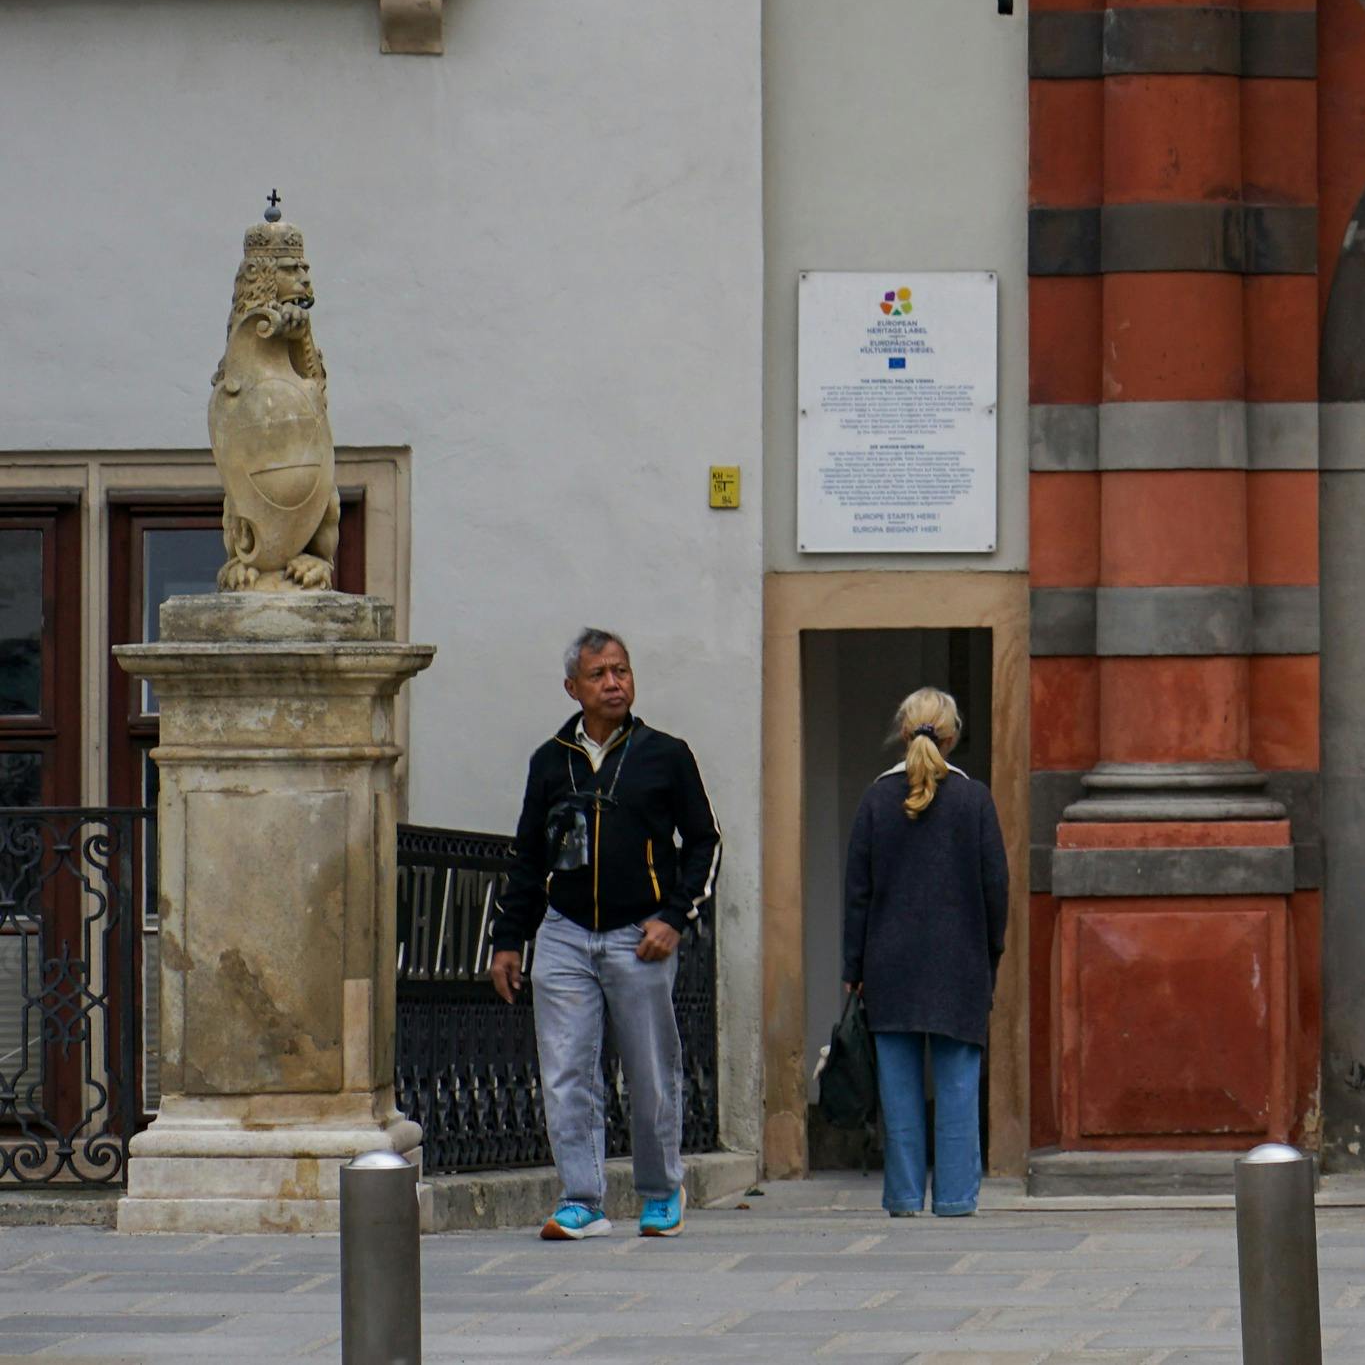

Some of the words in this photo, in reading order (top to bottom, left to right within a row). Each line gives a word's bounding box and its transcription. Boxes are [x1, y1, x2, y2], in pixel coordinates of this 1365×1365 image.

[854, 513, 885, 521] EUROPE
[886, 513, 915, 521] STARTS
[852, 526, 884, 534] EUROPA
